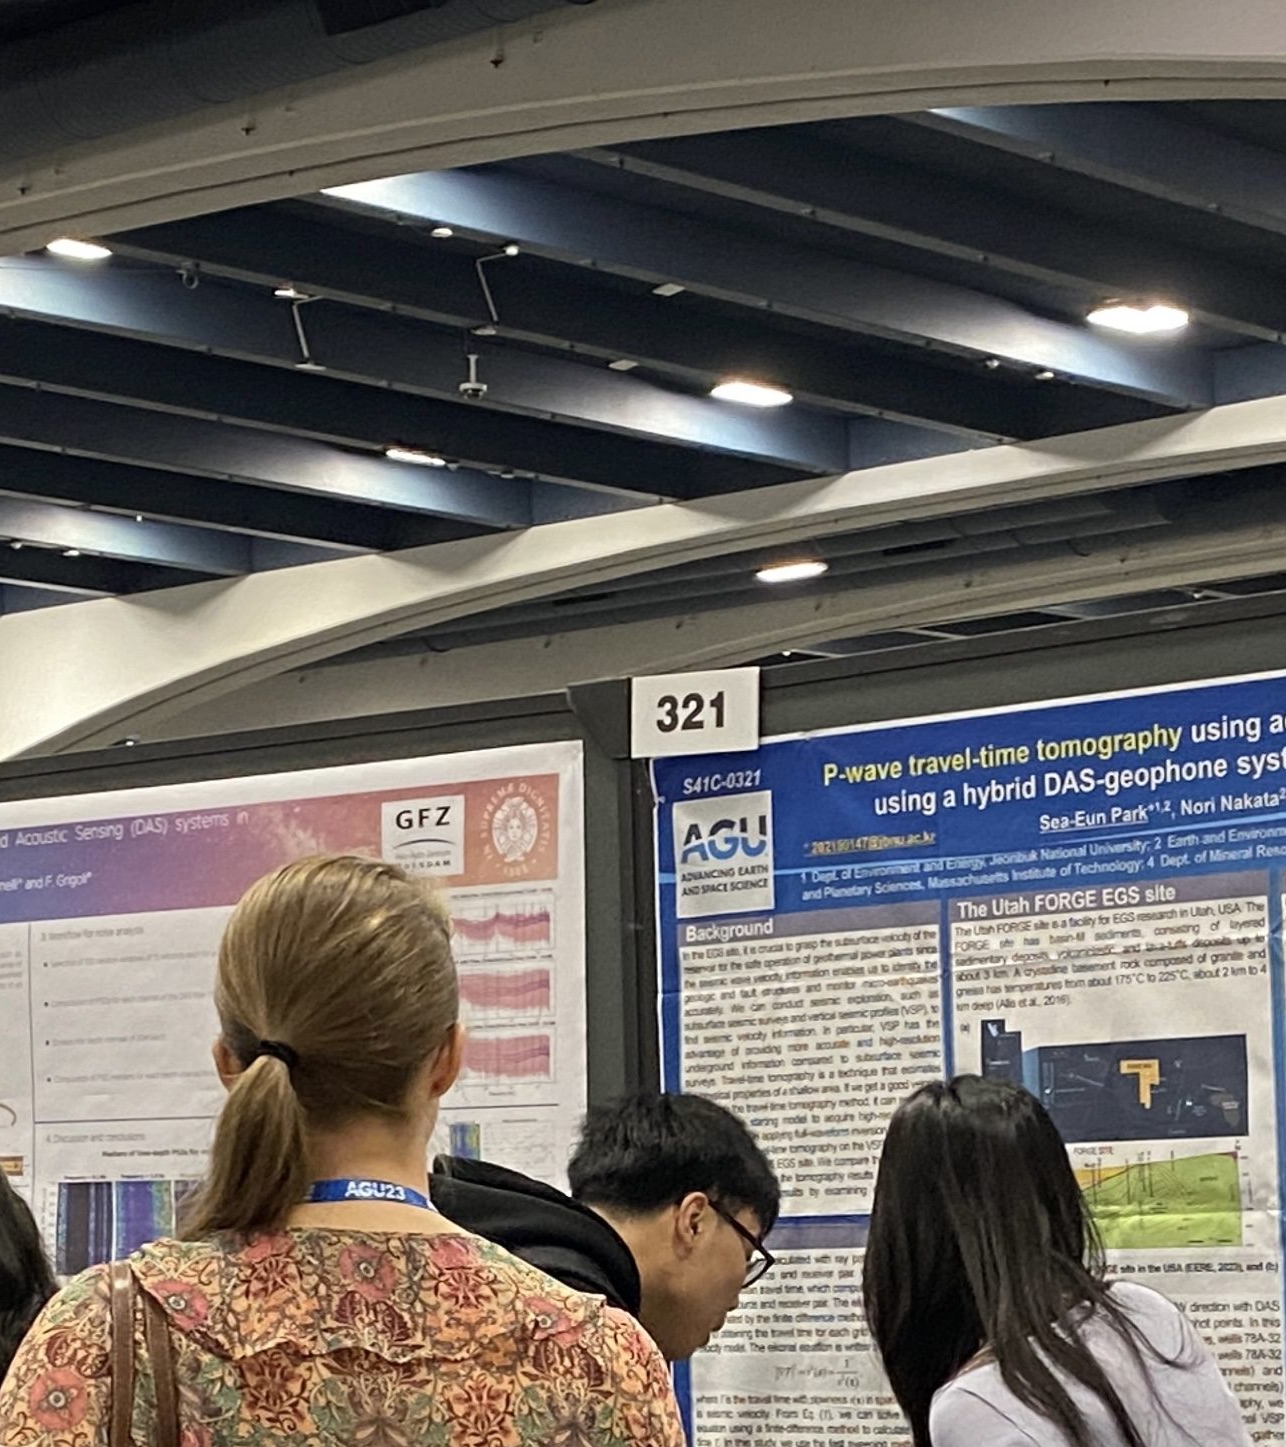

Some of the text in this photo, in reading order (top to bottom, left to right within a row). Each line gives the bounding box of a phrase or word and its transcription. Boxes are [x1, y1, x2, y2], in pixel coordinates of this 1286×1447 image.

[656, 691, 726, 733] 321
[823, 760, 902, 786] P-wave
[908, 744, 1030, 776] travel-time
[1036, 722, 1183, 760] tomography
[1191, 715, 1262, 742] using
[682, 769, 761, 794] S41C-0321
[874, 789, 937, 814] using
[942, 788, 956, 806] a
[962, 774, 1036, 808] hybrid
[1044, 757, 1227, 795] DAS-geophone
[396, 806, 451, 830] GFZ
[1039, 809, 1106, 830] Sea-Eun
[1180, 796, 1216, 815] Nori
[678, 814, 768, 863] AGU
[681, 864, 768, 881] ADVANCING EARTH
[681, 878, 768, 896] AND SPACE SCIENCE
[957, 883, 1176, 919] The Utah FORGE EGS site
[685, 918, 774, 943] Background
[345, 1180, 405, 1201] AGU23
